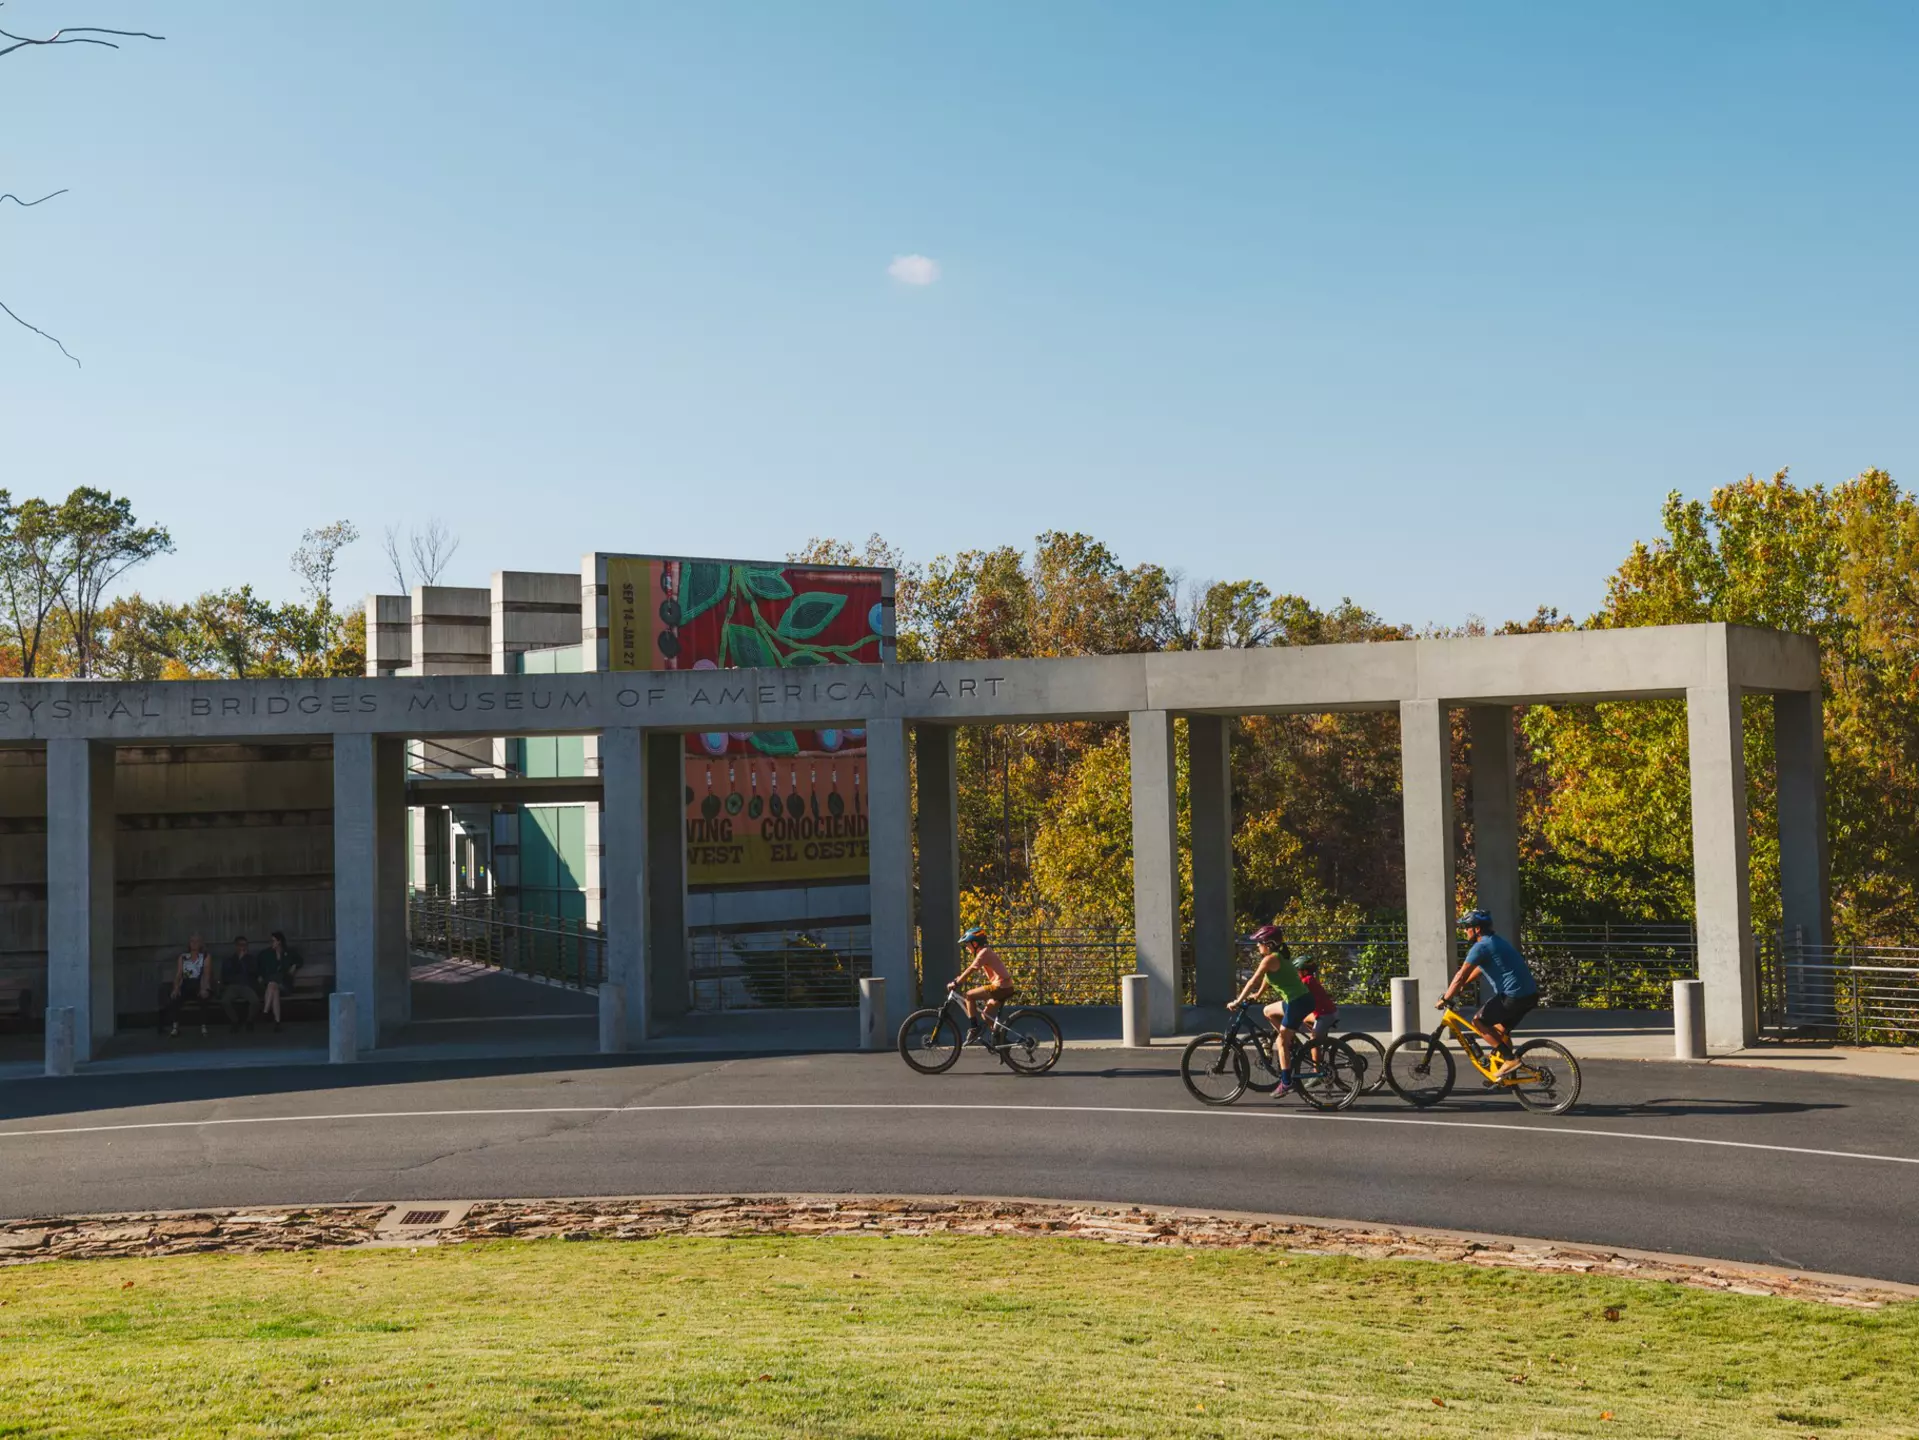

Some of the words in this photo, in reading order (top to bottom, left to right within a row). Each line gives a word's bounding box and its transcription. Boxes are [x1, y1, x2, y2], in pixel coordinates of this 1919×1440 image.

[622, 582, 634, 605] SEP
[622, 607, 635, 649] 14-JAN
[623, 651, 635, 666] 27
[191, 693, 378, 717] BRIDGES
[408, 688, 592, 713] MUSEUM
[616, 688, 667, 709] OF
[690, 680, 907, 706] AMERICAN
[929, 677, 1006, 699] ART
[770, 843, 798, 862] EL
